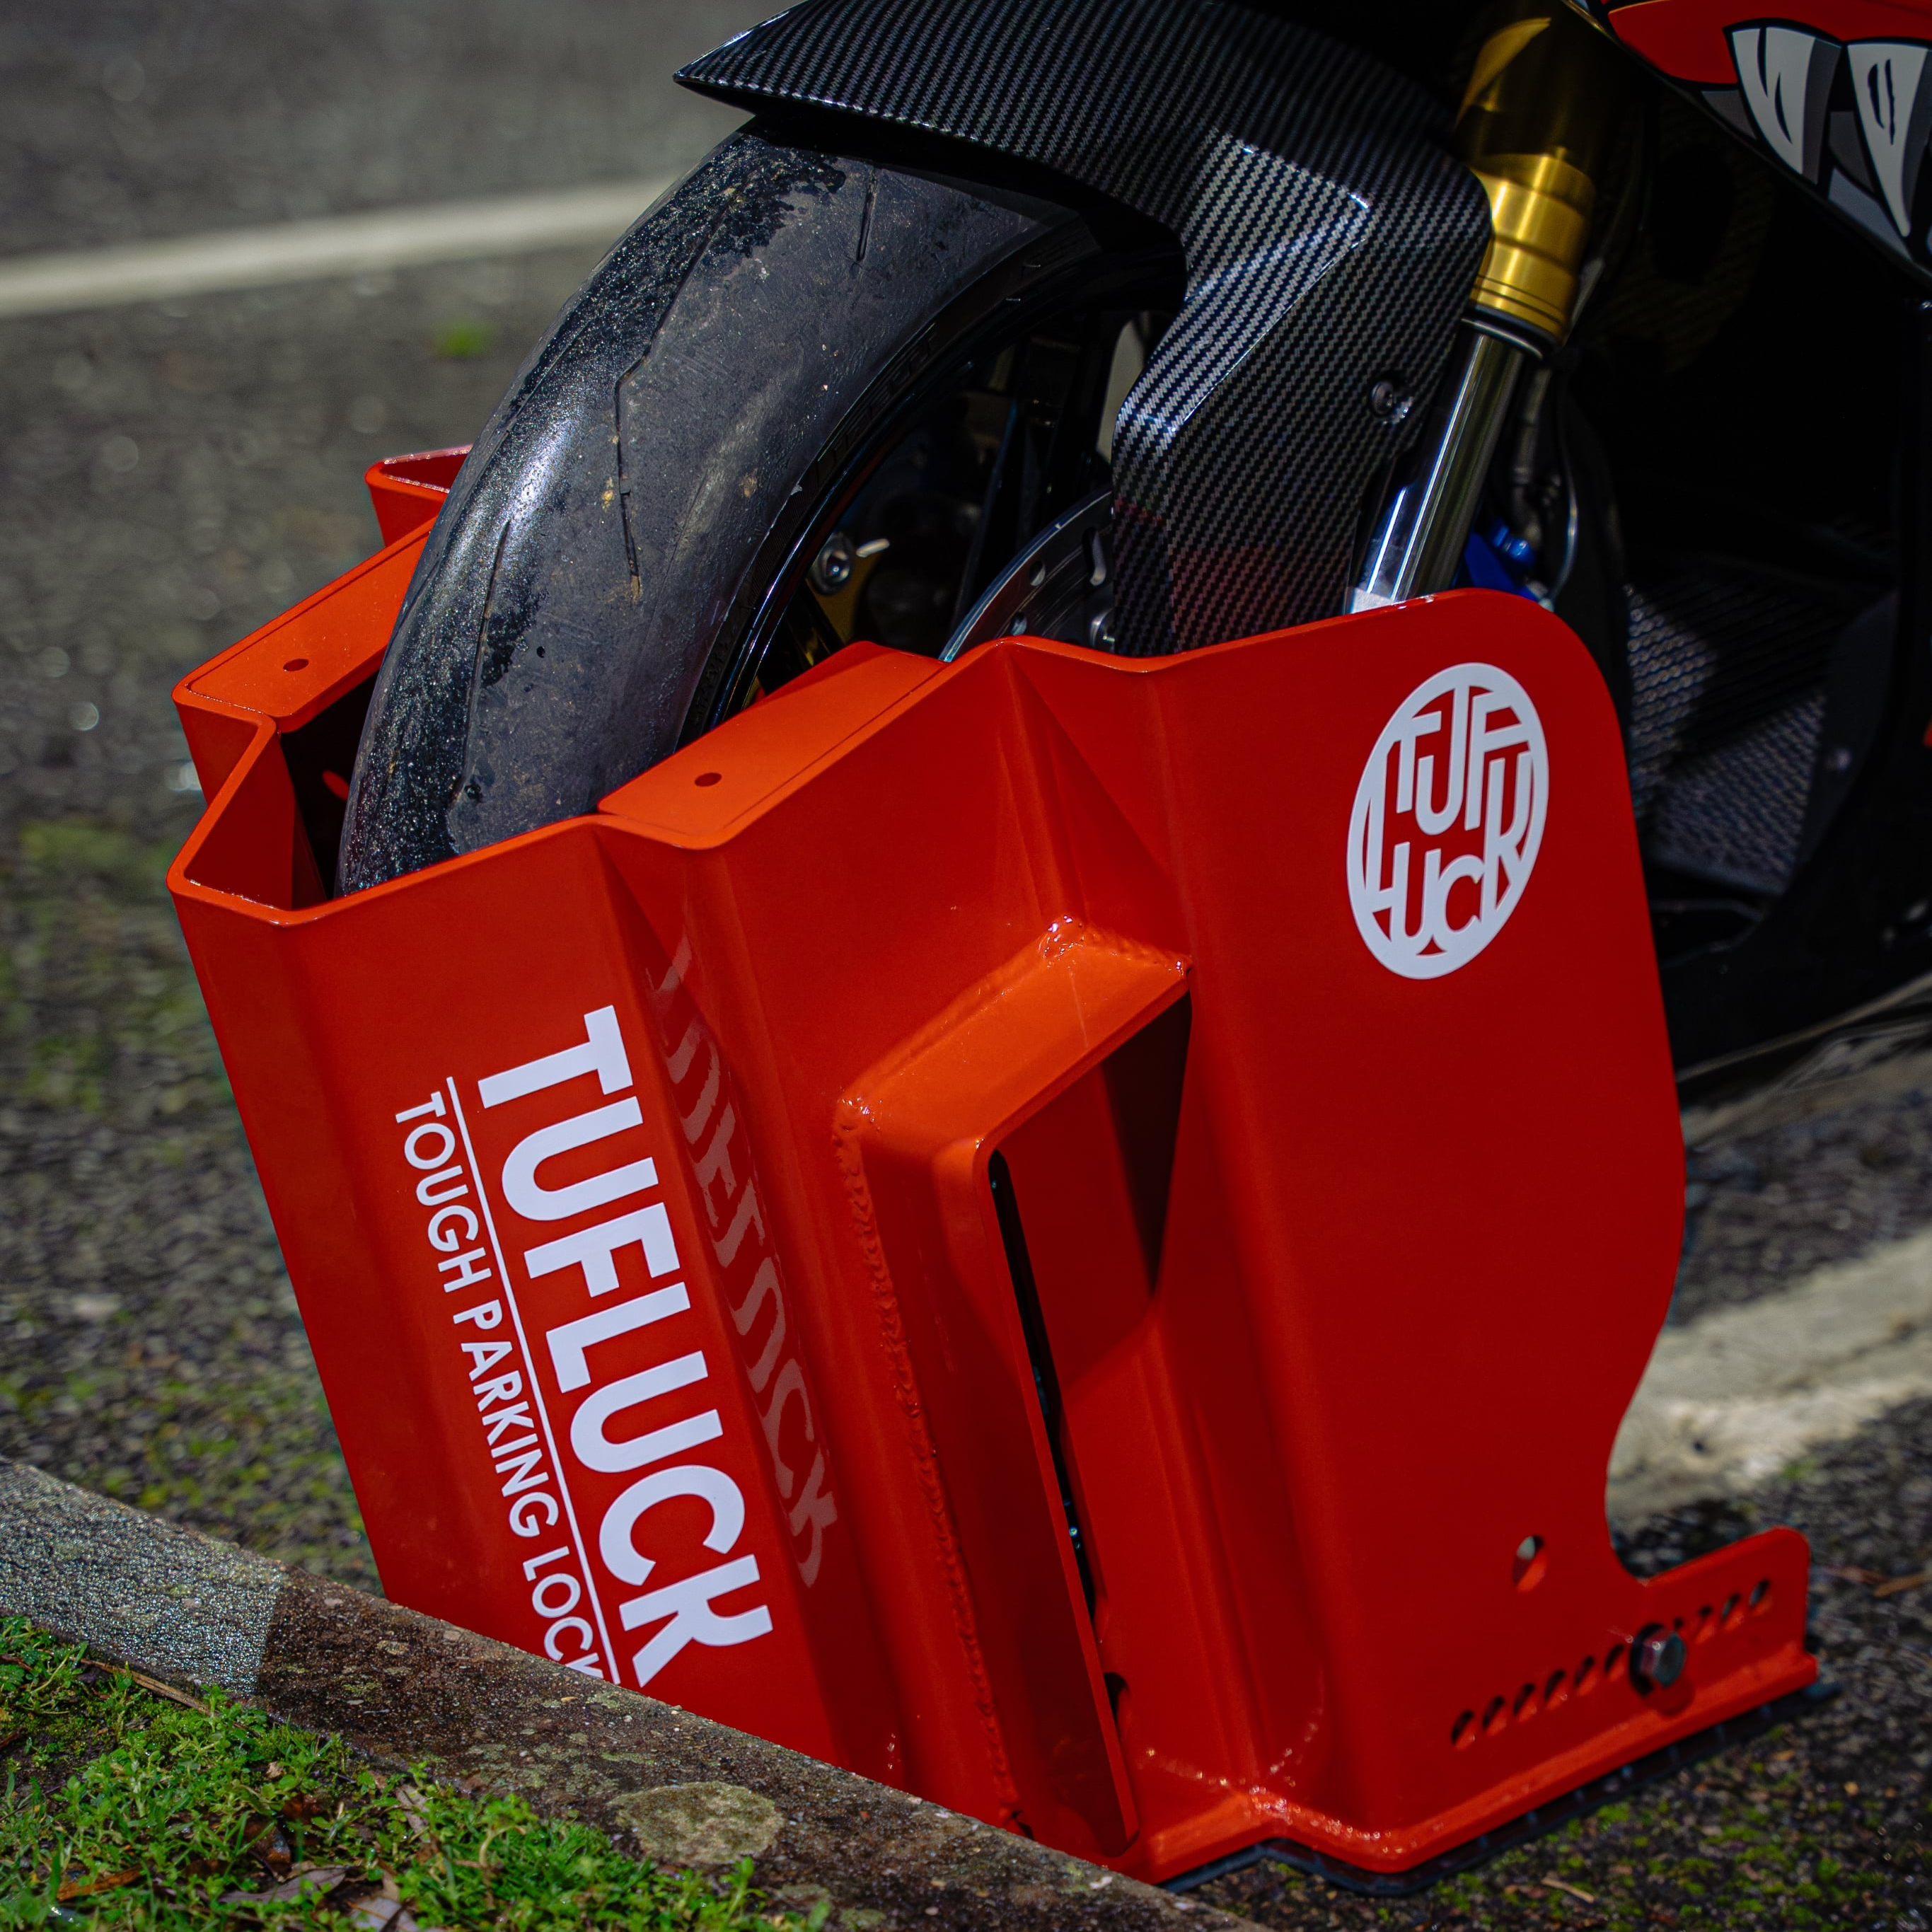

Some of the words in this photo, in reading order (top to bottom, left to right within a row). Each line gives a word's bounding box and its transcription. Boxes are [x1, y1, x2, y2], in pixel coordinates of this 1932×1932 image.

[396, 1092, 491, 1292] TOUGH
[453, 1300, 558, 1537] PARKING
[478, 1005, 773, 1687] TUFLUCK
